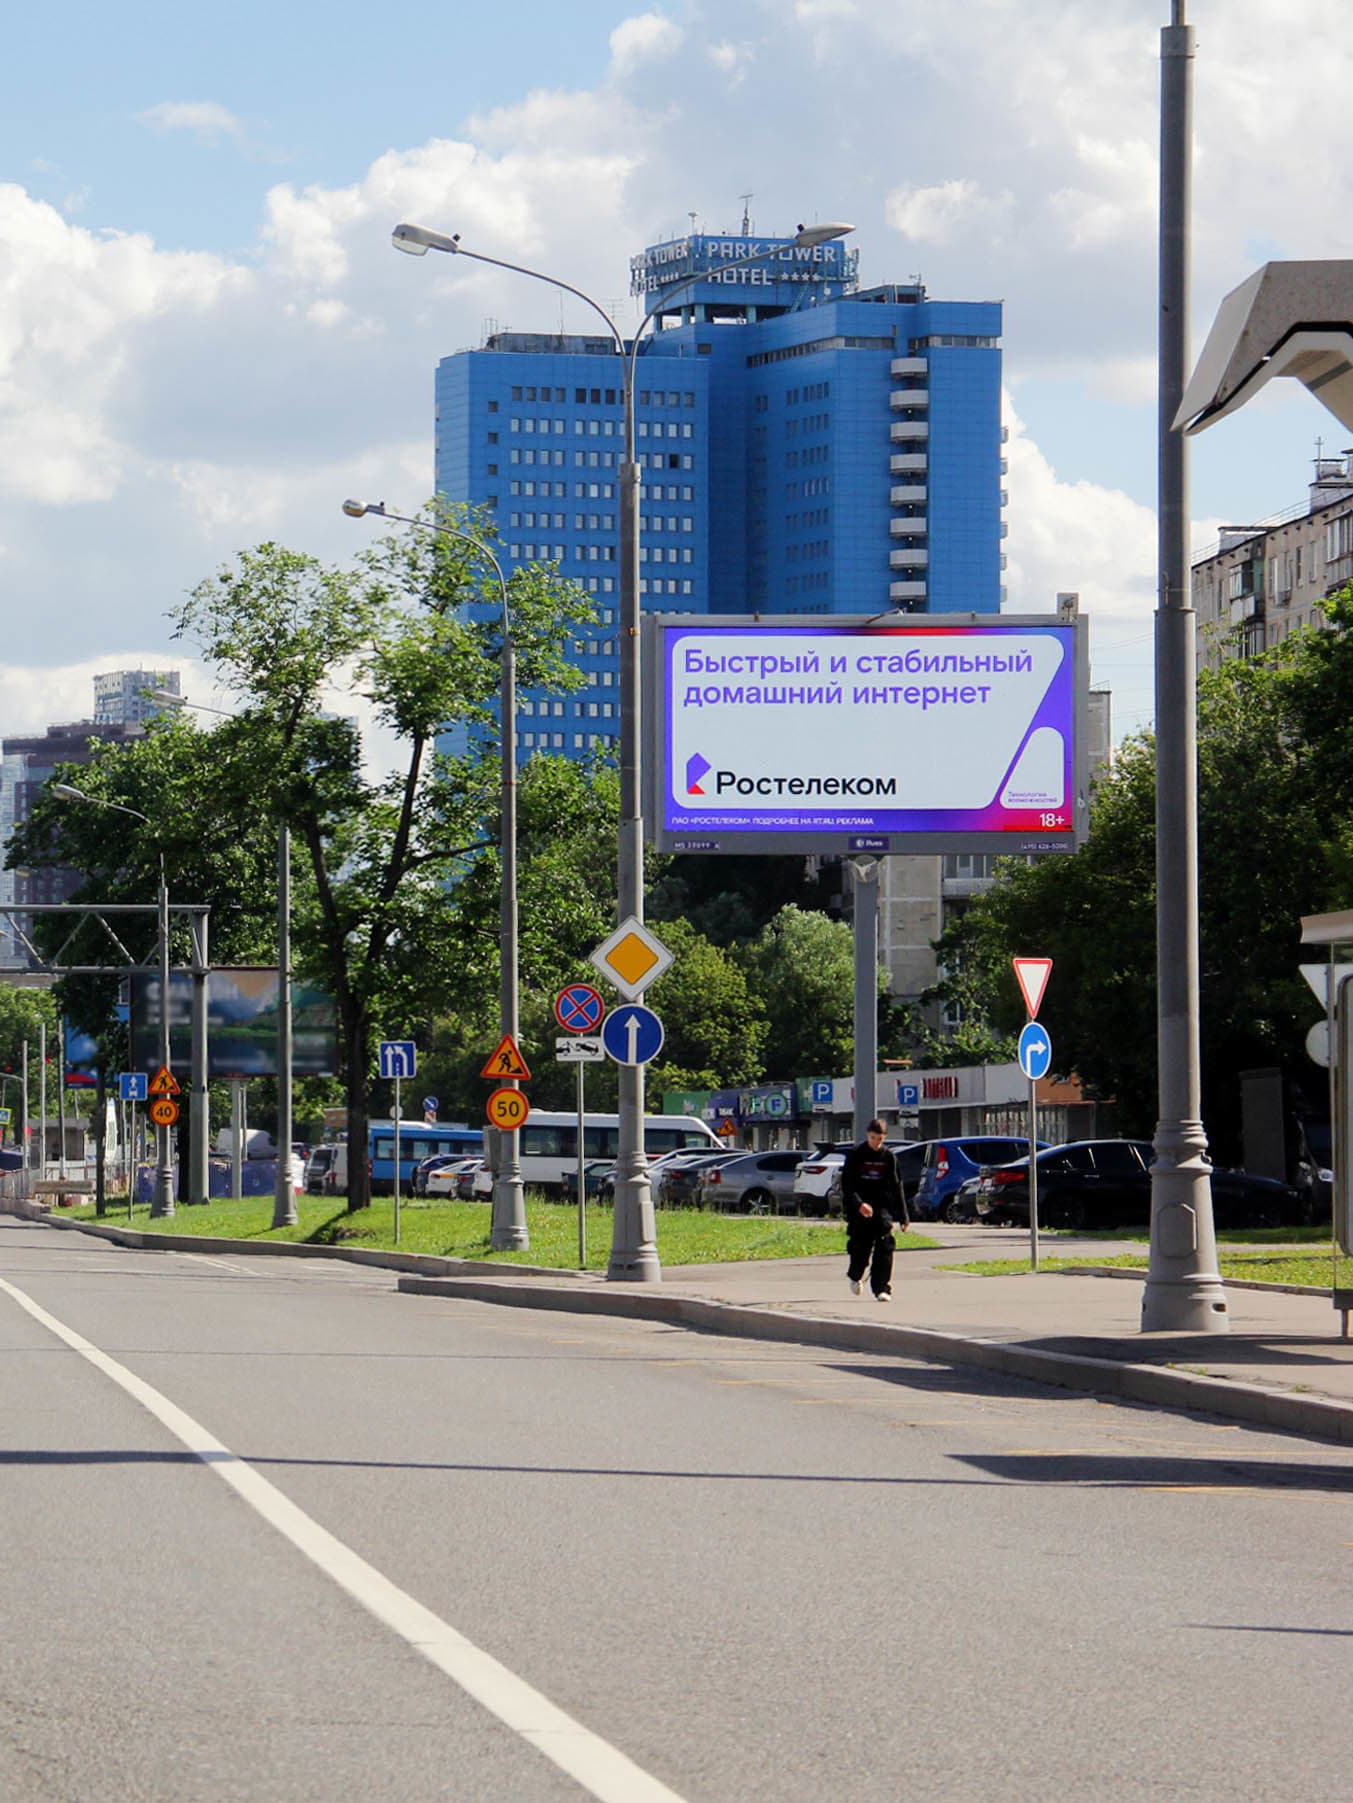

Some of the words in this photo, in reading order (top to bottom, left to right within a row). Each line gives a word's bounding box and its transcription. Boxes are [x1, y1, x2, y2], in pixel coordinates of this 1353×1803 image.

[707, 241, 761, 259] PARK
[767, 243, 836, 263] TOWER
[707, 267, 773, 286] HOTEL
[684, 648, 820, 679] Быстрый
[830, 653, 847, 672] и
[856, 649, 1033, 673] стабильный
[683, 681, 842, 708] домашний
[853, 685, 991, 710] интернет
[716, 770, 897, 795] Ростелеком
[671, 816, 689, 825] ПАО
[836, 816, 874, 825] РЕКЛАМА
[1039, 813, 1065, 828] 18+
[817, 1083, 830, 1100] P
[903, 1087, 915, 1103] P
[155, 1106, 173, 1118] 40
[496, 1100, 520, 1118] 50
